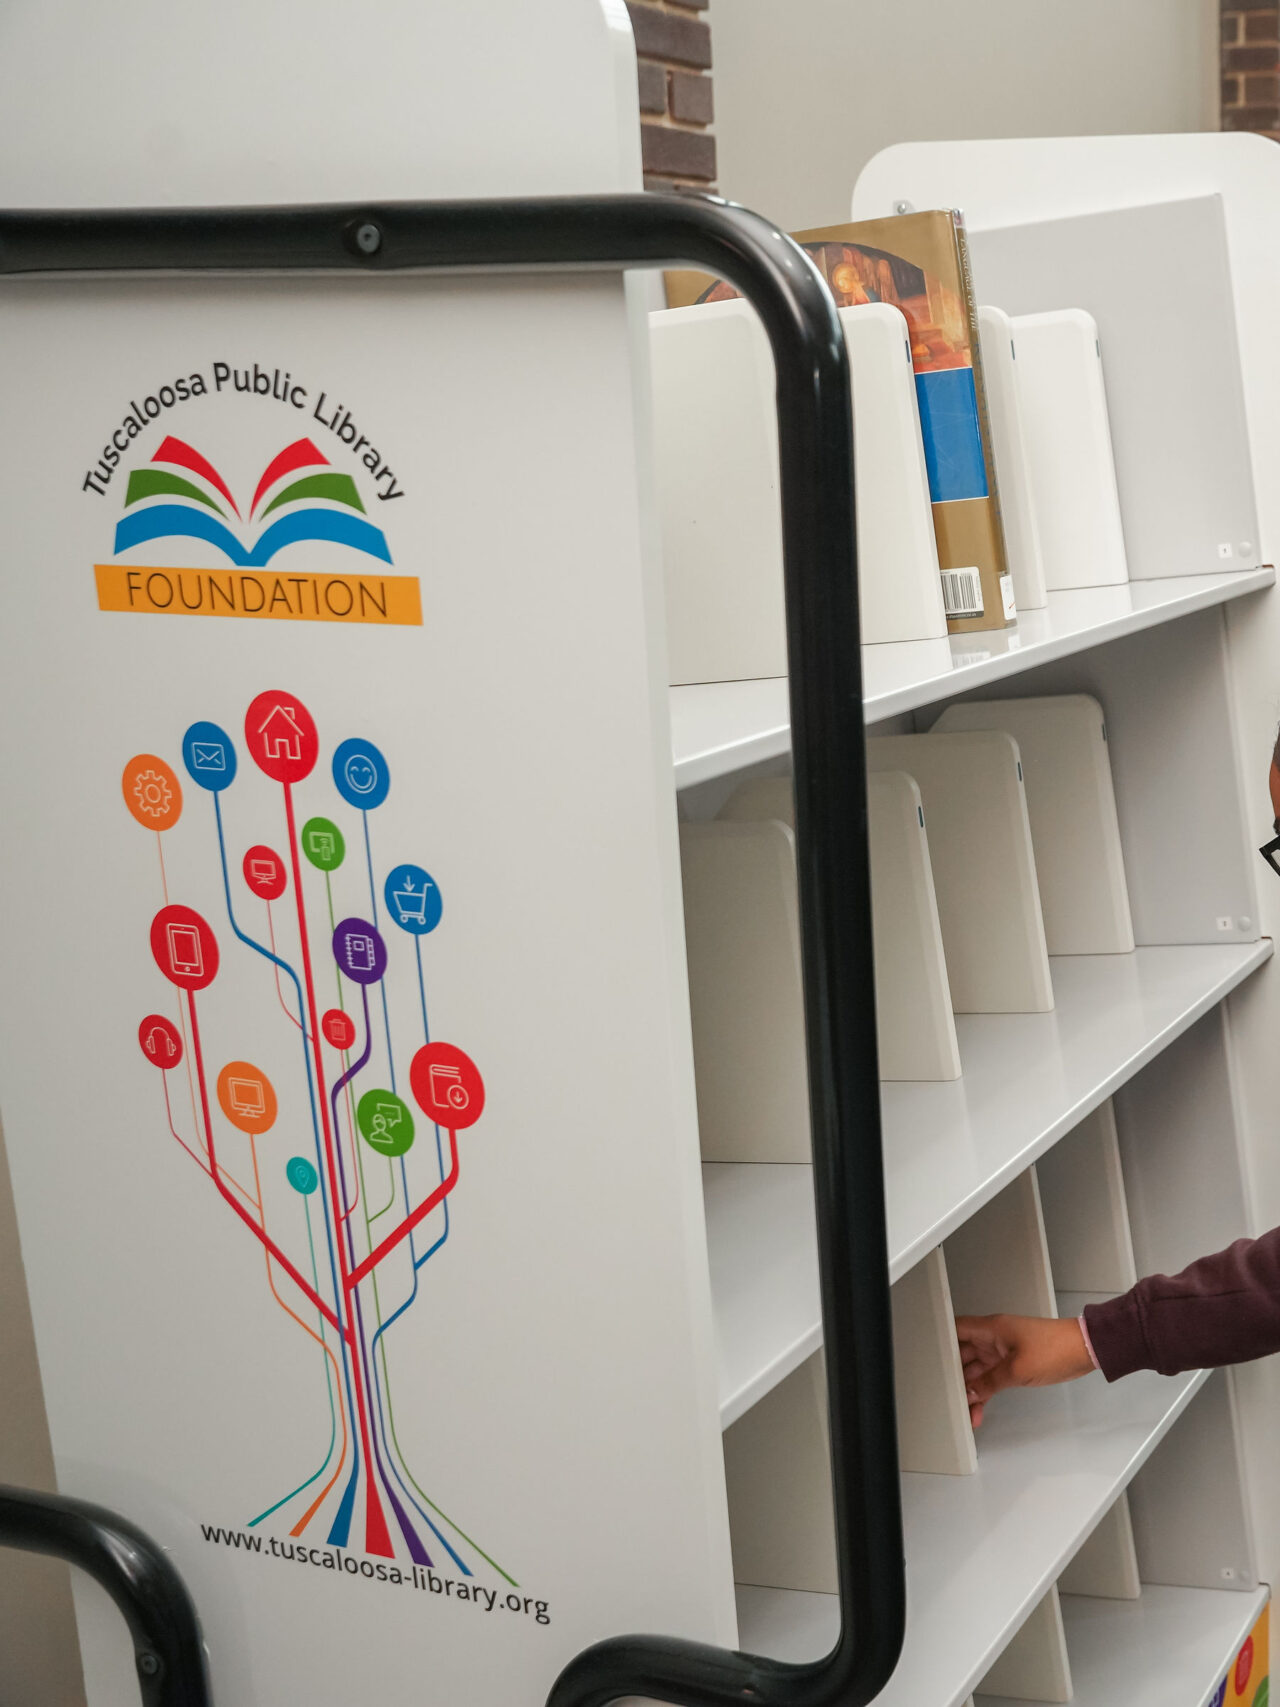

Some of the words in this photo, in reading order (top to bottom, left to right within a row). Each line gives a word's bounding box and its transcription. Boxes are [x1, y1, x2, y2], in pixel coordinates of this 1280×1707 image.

[82, 372, 207, 498] Tuscaloosa
[213, 361, 307, 409] Public
[313, 392, 405, 501] Library
[126, 571, 388, 617] FOUNDATION
[200, 1523, 551, 1625] www.tuscaloosa-library.org
